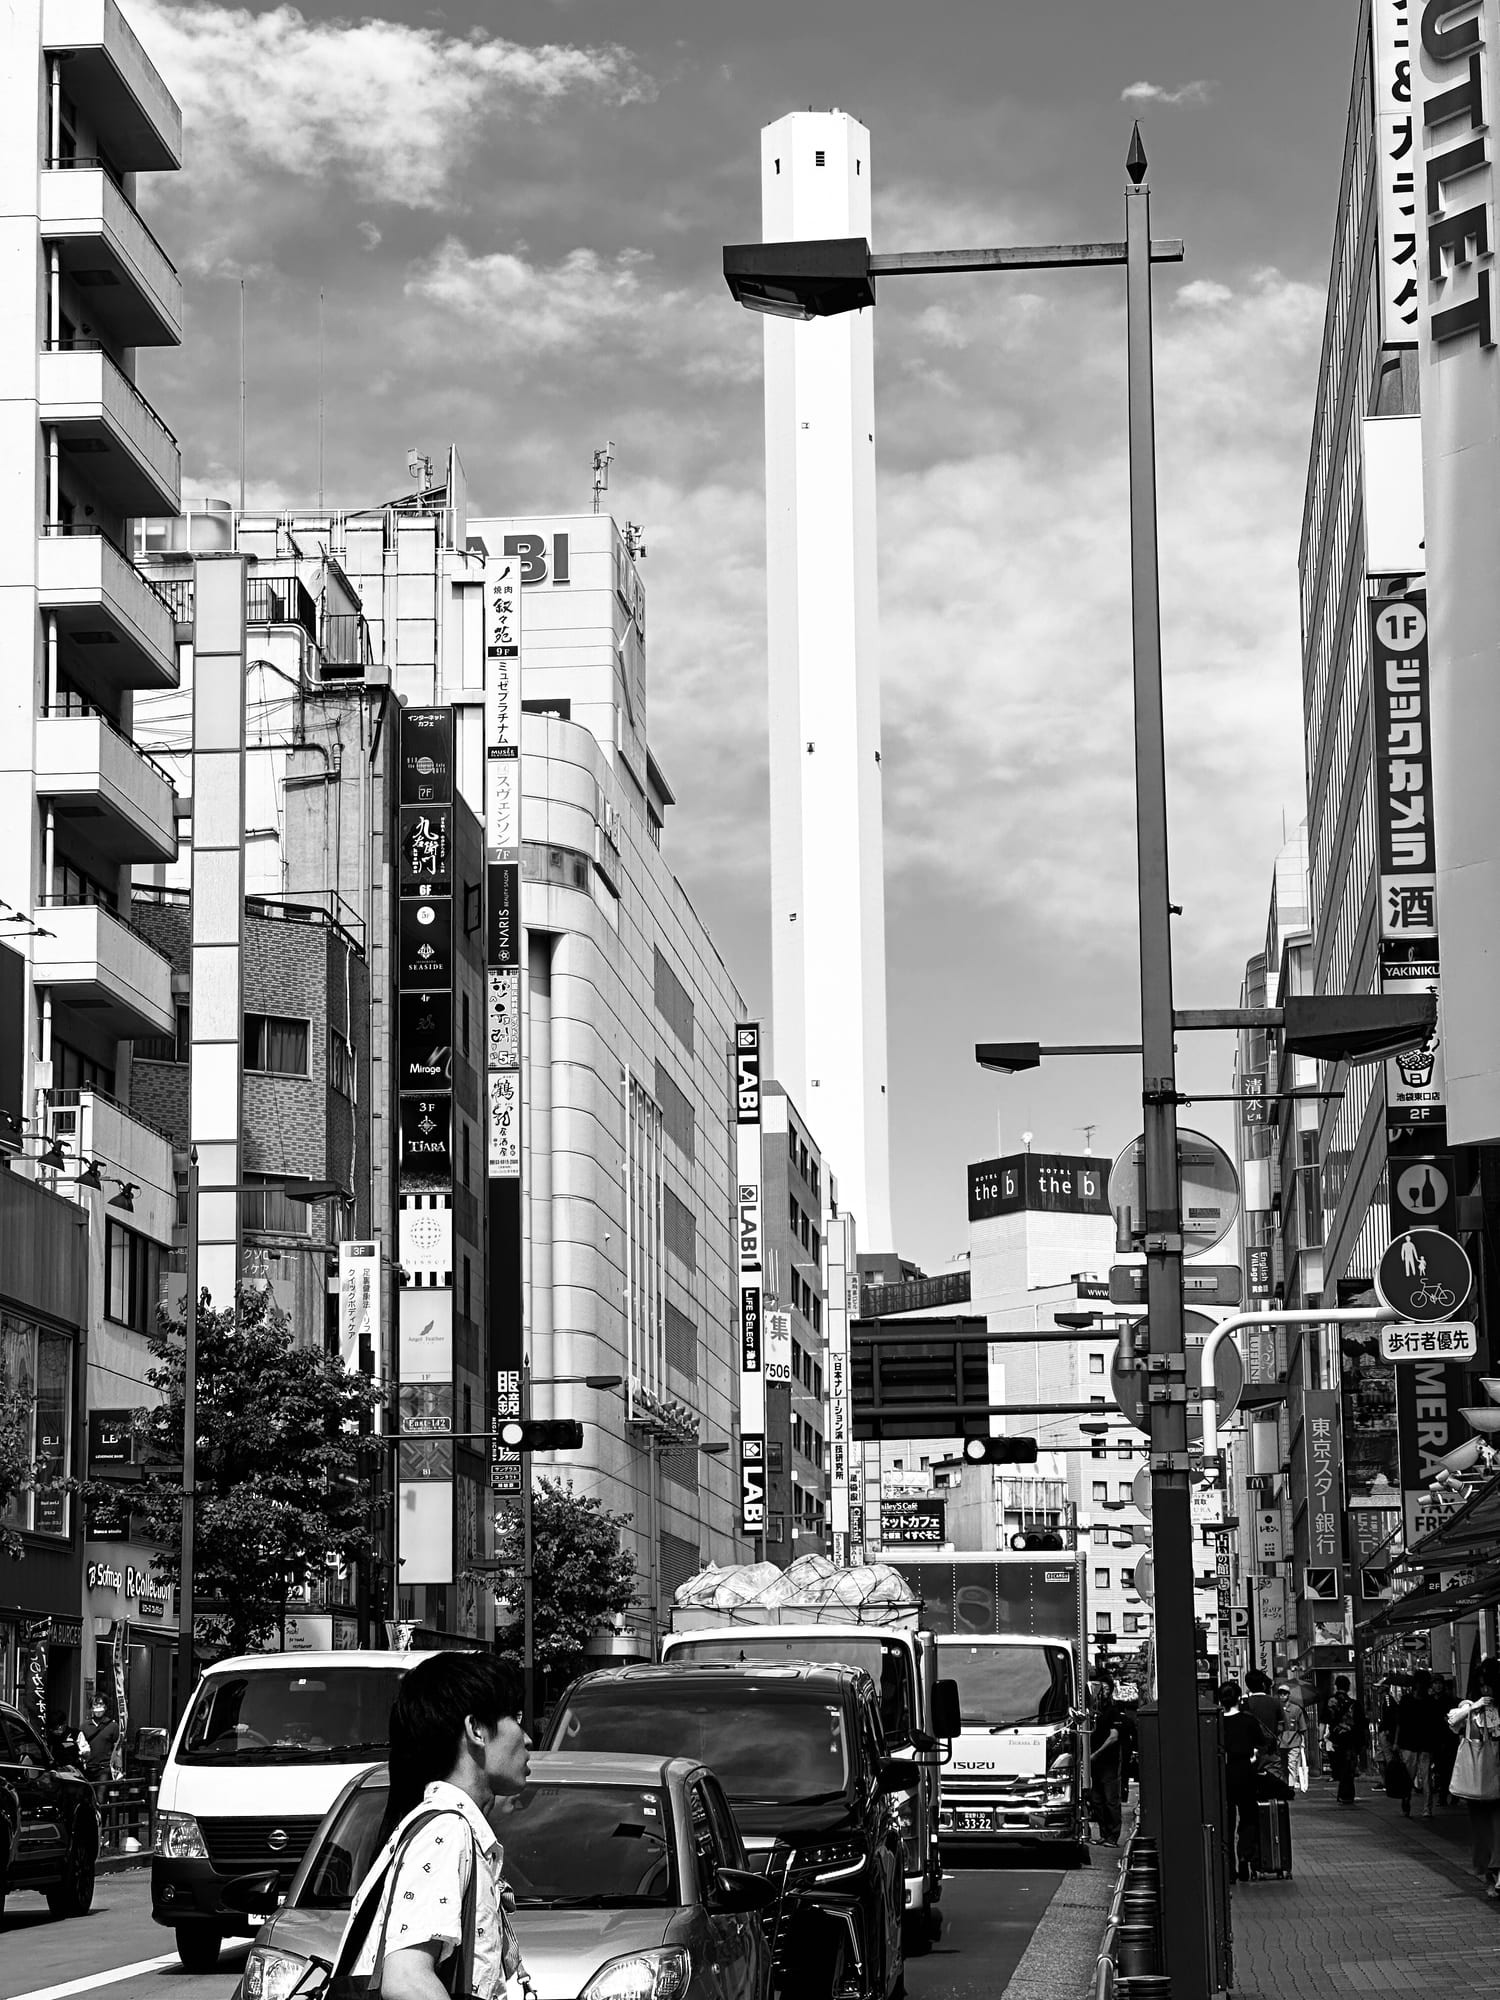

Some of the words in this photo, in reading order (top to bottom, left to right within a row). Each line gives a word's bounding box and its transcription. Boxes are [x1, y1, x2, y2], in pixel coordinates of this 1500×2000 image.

[1385, 615, 1417, 640] 1F
[496, 647, 510, 656] 9F
[497, 661, 509, 744] ミュゼプラチナム
[420, 788, 432, 797] 7F
[496, 849, 510, 860] 7F
[419, 884, 432, 896] 6F
[1388, 886, 1434, 928] 酒
[499, 909, 510, 948] NARIS
[410, 1063, 441, 1075] Mirage
[738, 1054, 759, 1118] LABI
[419, 1102, 435, 1113] 3F
[1409, 1108, 1430, 1120] 2F
[974, 1184, 998, 1201] the
[1039, 1176, 1072, 1194] the
[741, 1205, 757, 1259] LABI
[353, 1246, 366, 1256] 3F
[1260, 1251, 1269, 1282] English
[1388, 1330, 1469, 1353] 歩行者優先
[1414, 1363, 1448, 1480] MERA
[1311, 1417, 1337, 1555] 東京スター銀行
[743, 1466, 763, 1531] LABI
[97, 1563, 123, 1594] Sofmap
[953, 1762, 995, 1770] ISUZU
[965, 1819, 991, 1829] 33-22
